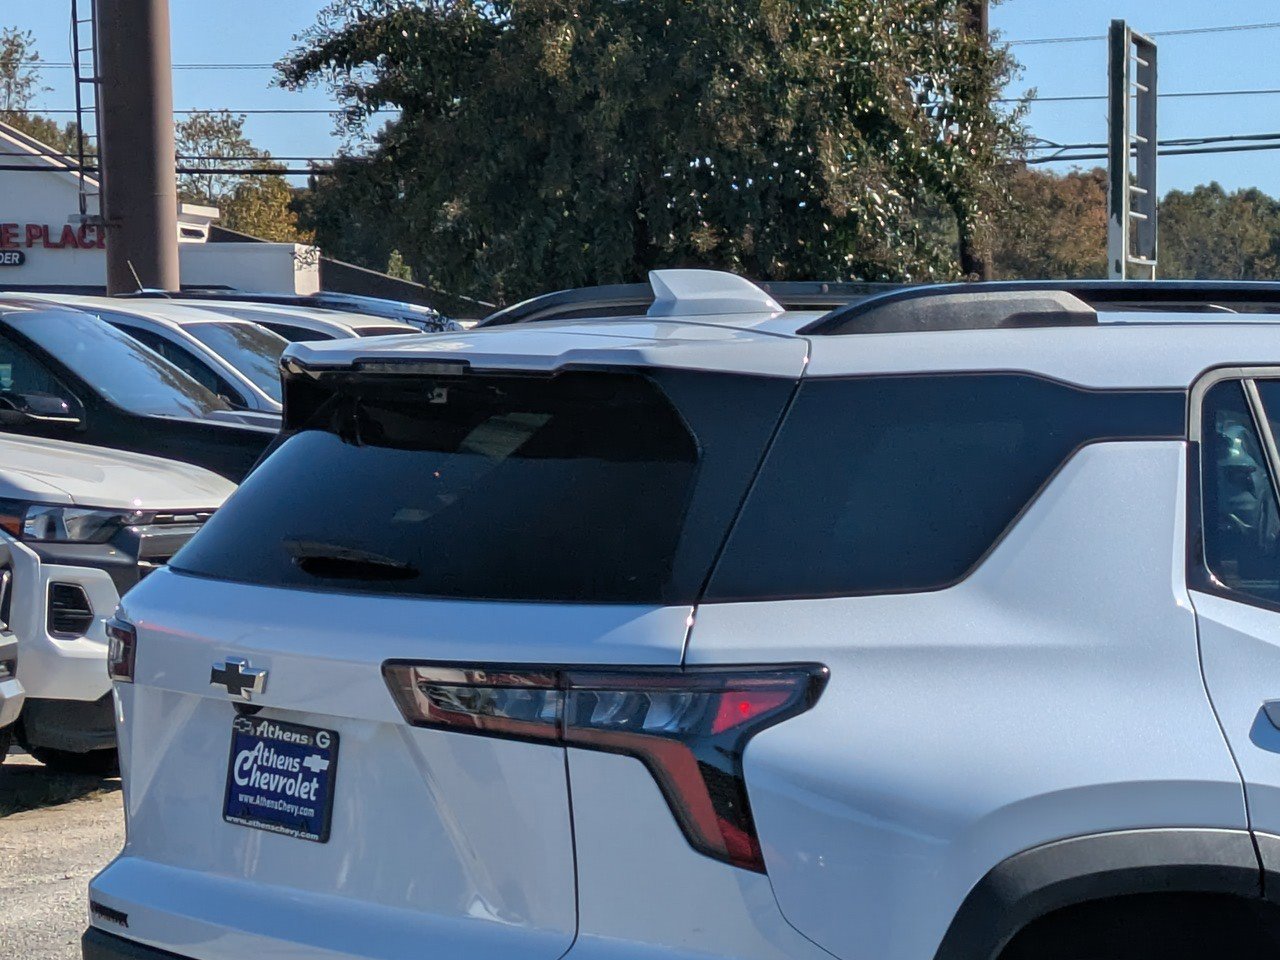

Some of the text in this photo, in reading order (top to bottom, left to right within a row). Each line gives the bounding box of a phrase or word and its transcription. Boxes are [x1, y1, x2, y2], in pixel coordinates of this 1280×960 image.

[256, 720, 309, 745] Athens
[249, 741, 301, 773] Athens
[233, 750, 319, 802] Chevrolet
[238, 793, 315, 818] www.AthensChevy.com
[225, 815, 319, 840] www.athenschevy.com
